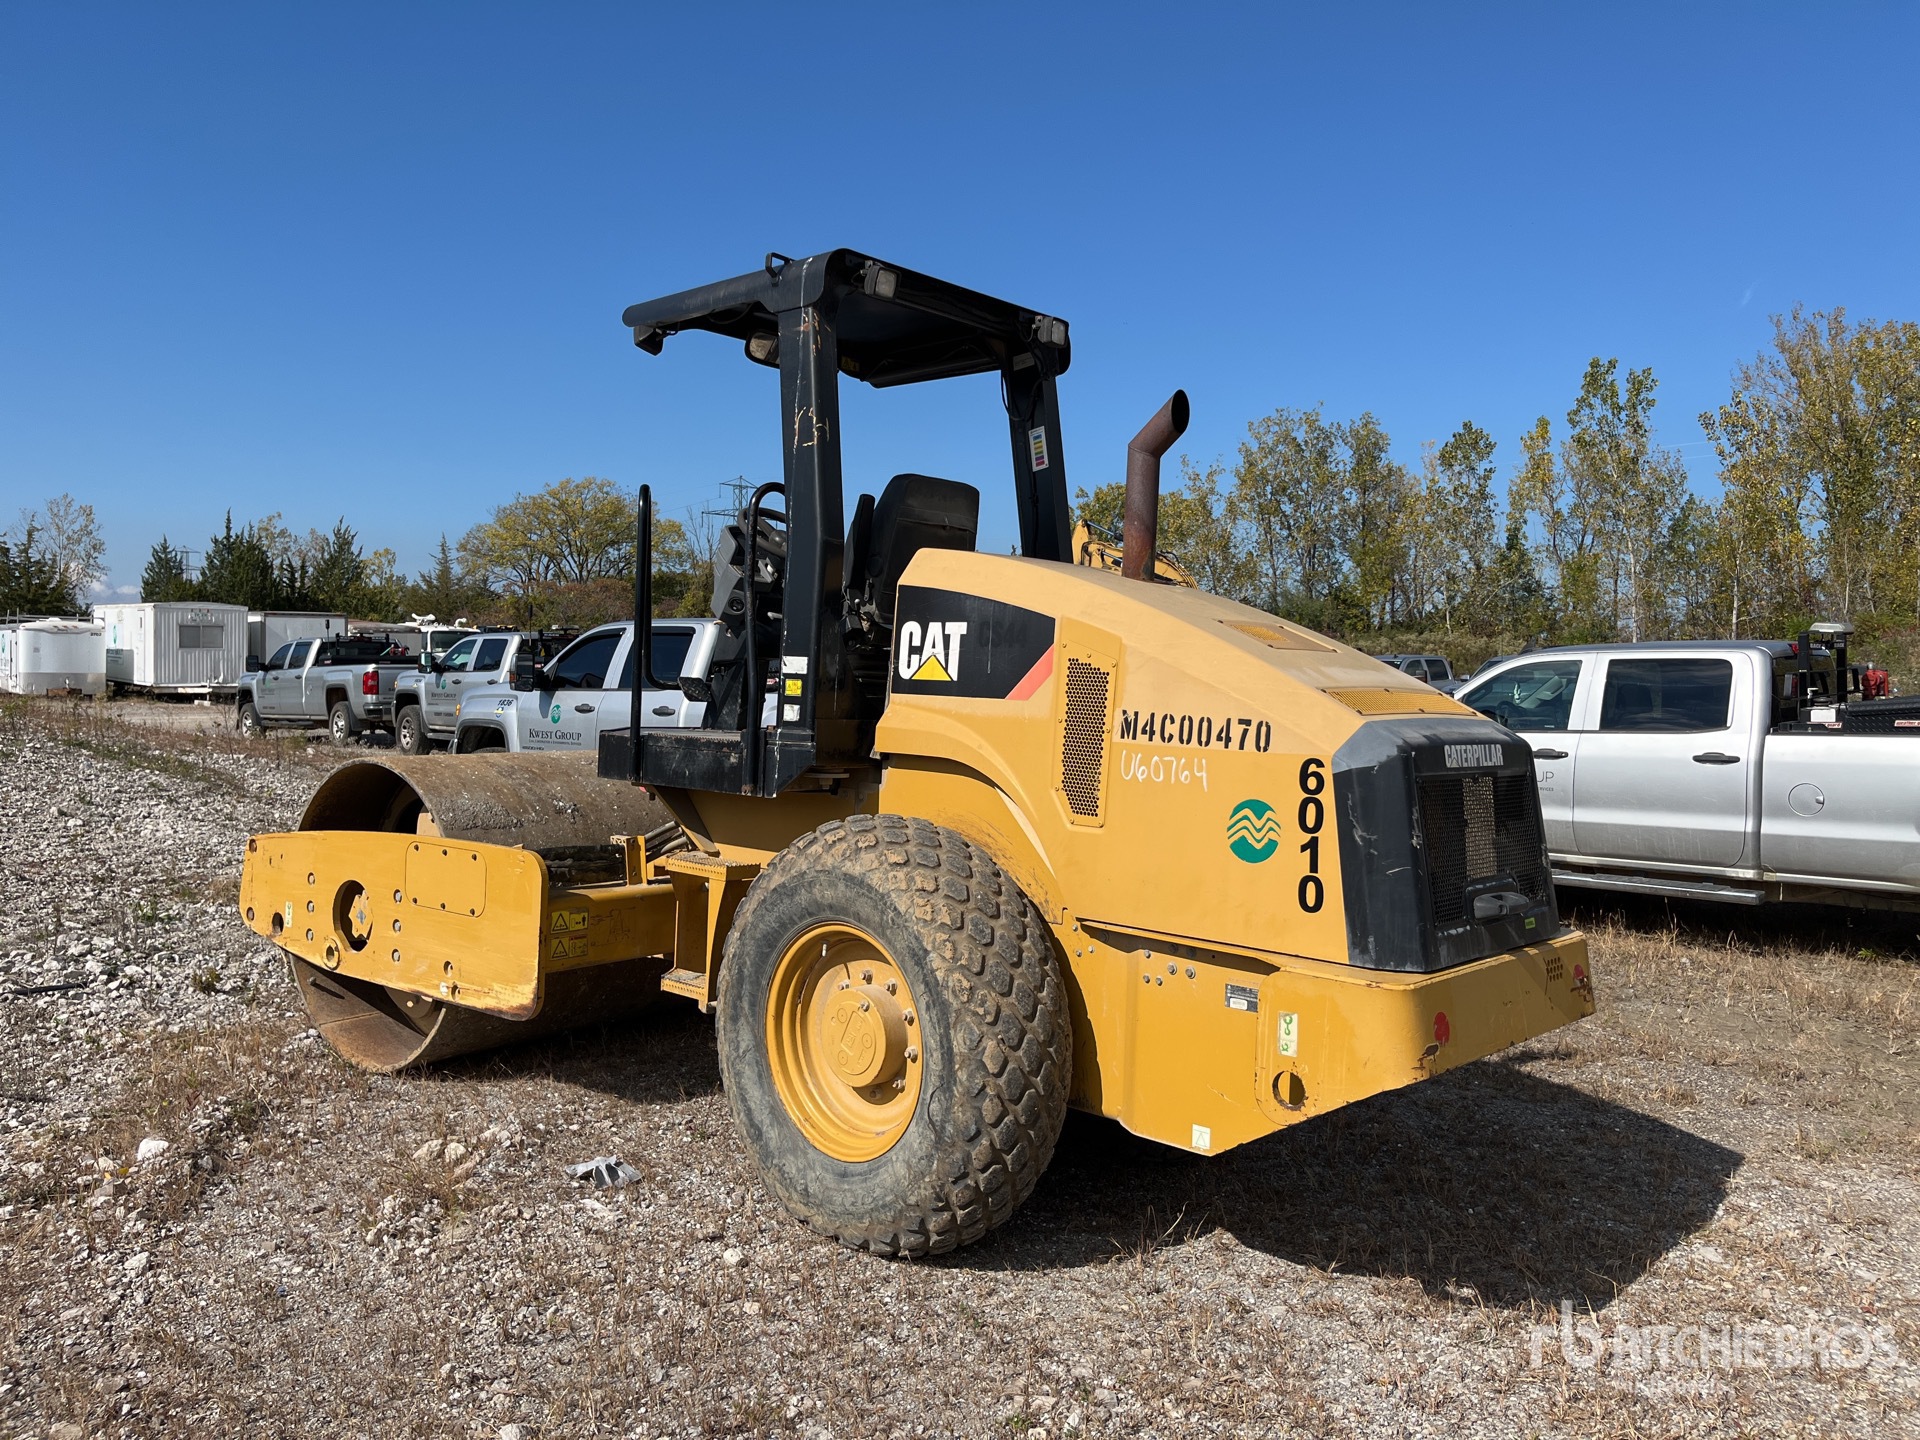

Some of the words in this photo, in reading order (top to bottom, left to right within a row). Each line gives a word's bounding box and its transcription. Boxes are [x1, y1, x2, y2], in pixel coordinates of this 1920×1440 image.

[899, 621, 968, 682] CAT
[529, 728, 553, 740] KWEST
[555, 729, 582, 741] GROUP
[1120, 709, 1272, 753] M4C00470
[1120, 750, 1208, 793] U60764
[1444, 743, 1504, 768] CATERPILLAR
[1298, 757, 1326, 914] 6010
